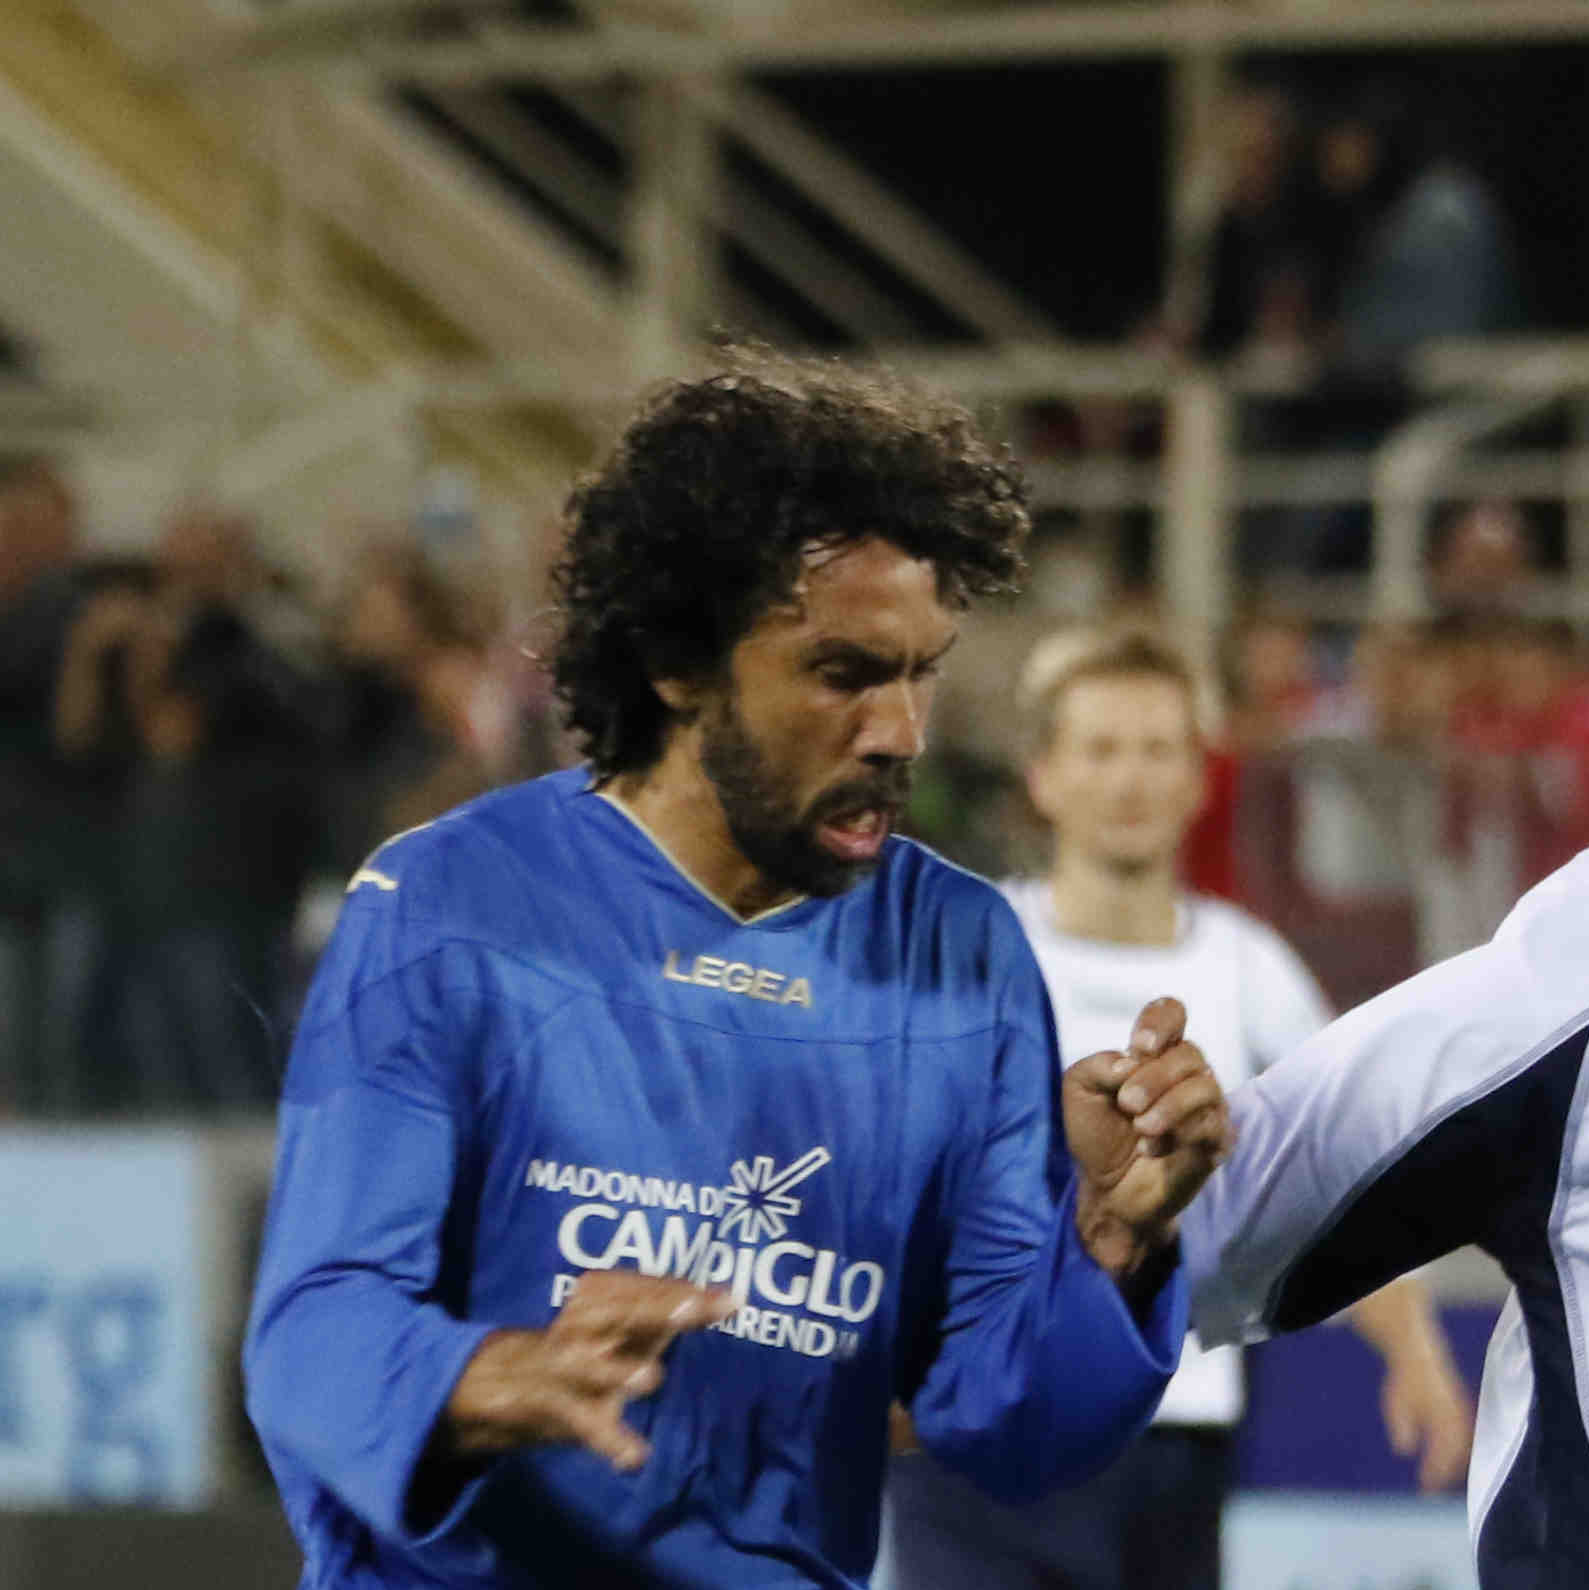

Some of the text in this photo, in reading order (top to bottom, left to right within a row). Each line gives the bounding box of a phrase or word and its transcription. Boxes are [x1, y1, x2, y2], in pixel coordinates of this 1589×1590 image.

[663, 951, 812, 1007] LEGEA
[526, 1160, 733, 1220] MADONNA DI
